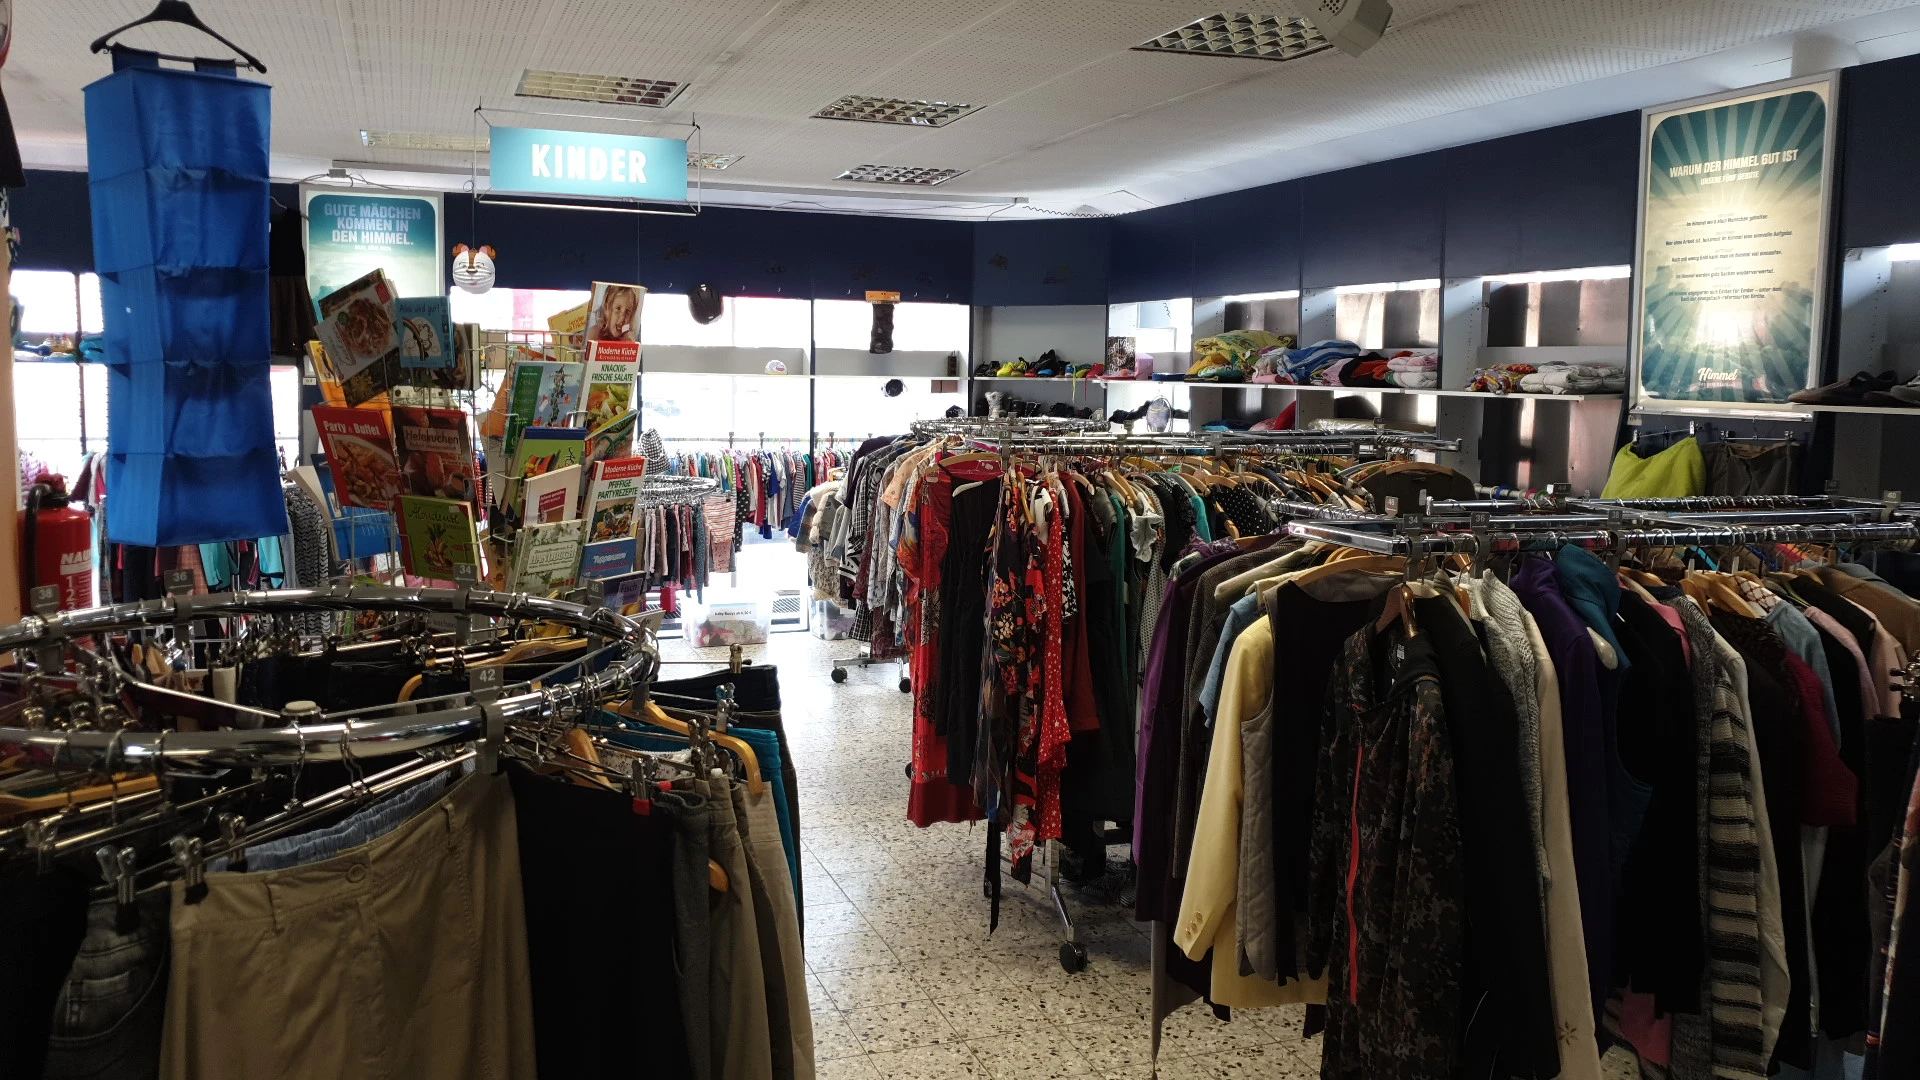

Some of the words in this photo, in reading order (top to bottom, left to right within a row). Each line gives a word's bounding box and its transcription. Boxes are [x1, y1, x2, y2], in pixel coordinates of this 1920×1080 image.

[531, 143, 647, 184] KINDER
[1670, 163, 1702, 178] WARUM
[1703, 160, 1722, 173] DER
[1722, 155, 1759, 170] HIMMEL
[1761, 151, 1780, 166] GUT
[1782, 149, 1799, 163] IST
[324, 203, 356, 216] GUTE
[360, 203, 421, 219] MÄDCHEN
[337, 217, 392, 231] KOMMEN
[396, 220, 409, 232] IN
[332, 229, 358, 243] DEN
[361, 231, 414, 246] HIMMEL.
[597, 346, 621, 355] Moderne
[621, 347, 637, 356] Küche
[592, 373, 613, 381] FRISCHE
[614, 373, 633, 381] SALATE
[1698, 367, 1739, 381] Himmel
[323, 420, 347, 434] Party
[354, 423, 381, 436] Buffet
[405, 429, 459, 445] Hefekuchen
[604, 465, 627, 474] Moderne
[627, 463, 642, 471] Küche
[608, 479, 632, 489] PFIFFIGE
[597, 487, 639, 499] PARTYREZEPTE
[1408, 516, 1418, 524] 34
[172, 571, 188, 582] 36
[460, 565, 471, 575] 34
[66, 575, 73, 588] 1
[591, 583, 599, 593] 46
[66, 589, 75, 602] 2
[480, 669, 496, 682] 42
